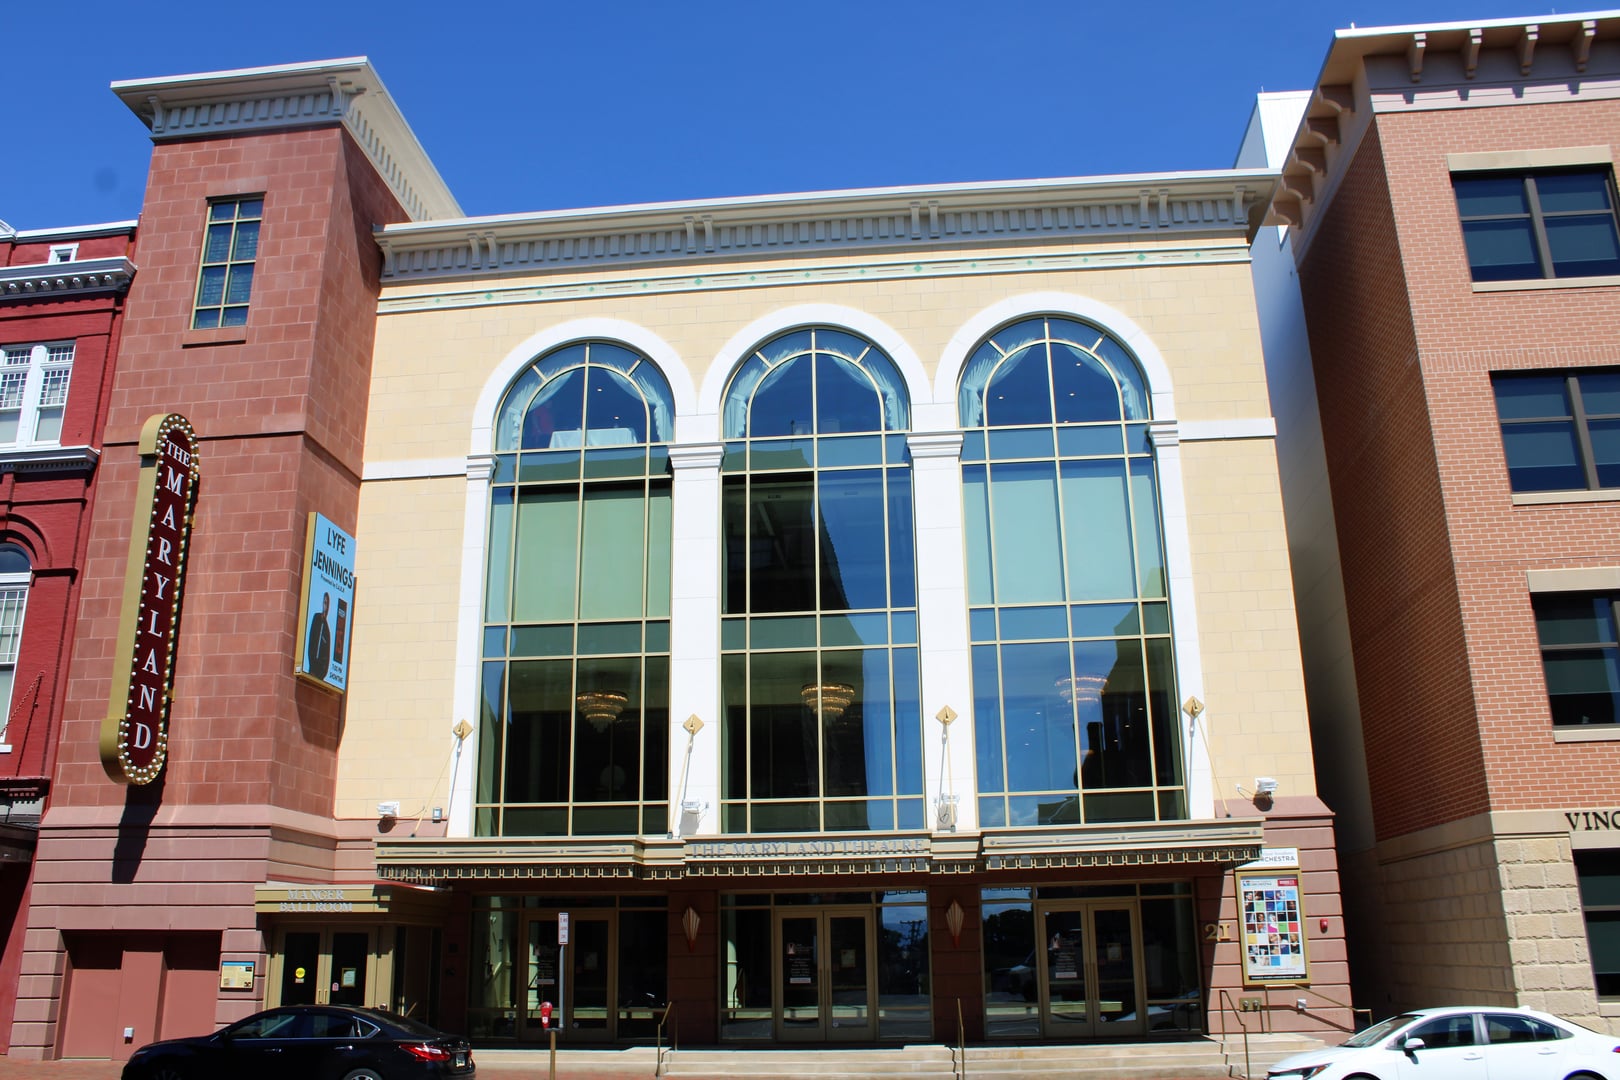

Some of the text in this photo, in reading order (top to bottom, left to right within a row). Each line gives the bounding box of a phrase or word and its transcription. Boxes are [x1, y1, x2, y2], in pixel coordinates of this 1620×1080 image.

[166, 439, 191, 467] THE
[327, 527, 346, 555] LYFE
[313, 549, 353, 590] JENNINGS
[133, 465, 184, 750] MARYLAND
[690, 839, 926, 857] THE MARYLAND THEATRE
[1260, 855, 1296, 863] RCHESTRA
[280, 902, 352, 912] BALLROOM
[1205, 924, 1231, 941] 21
